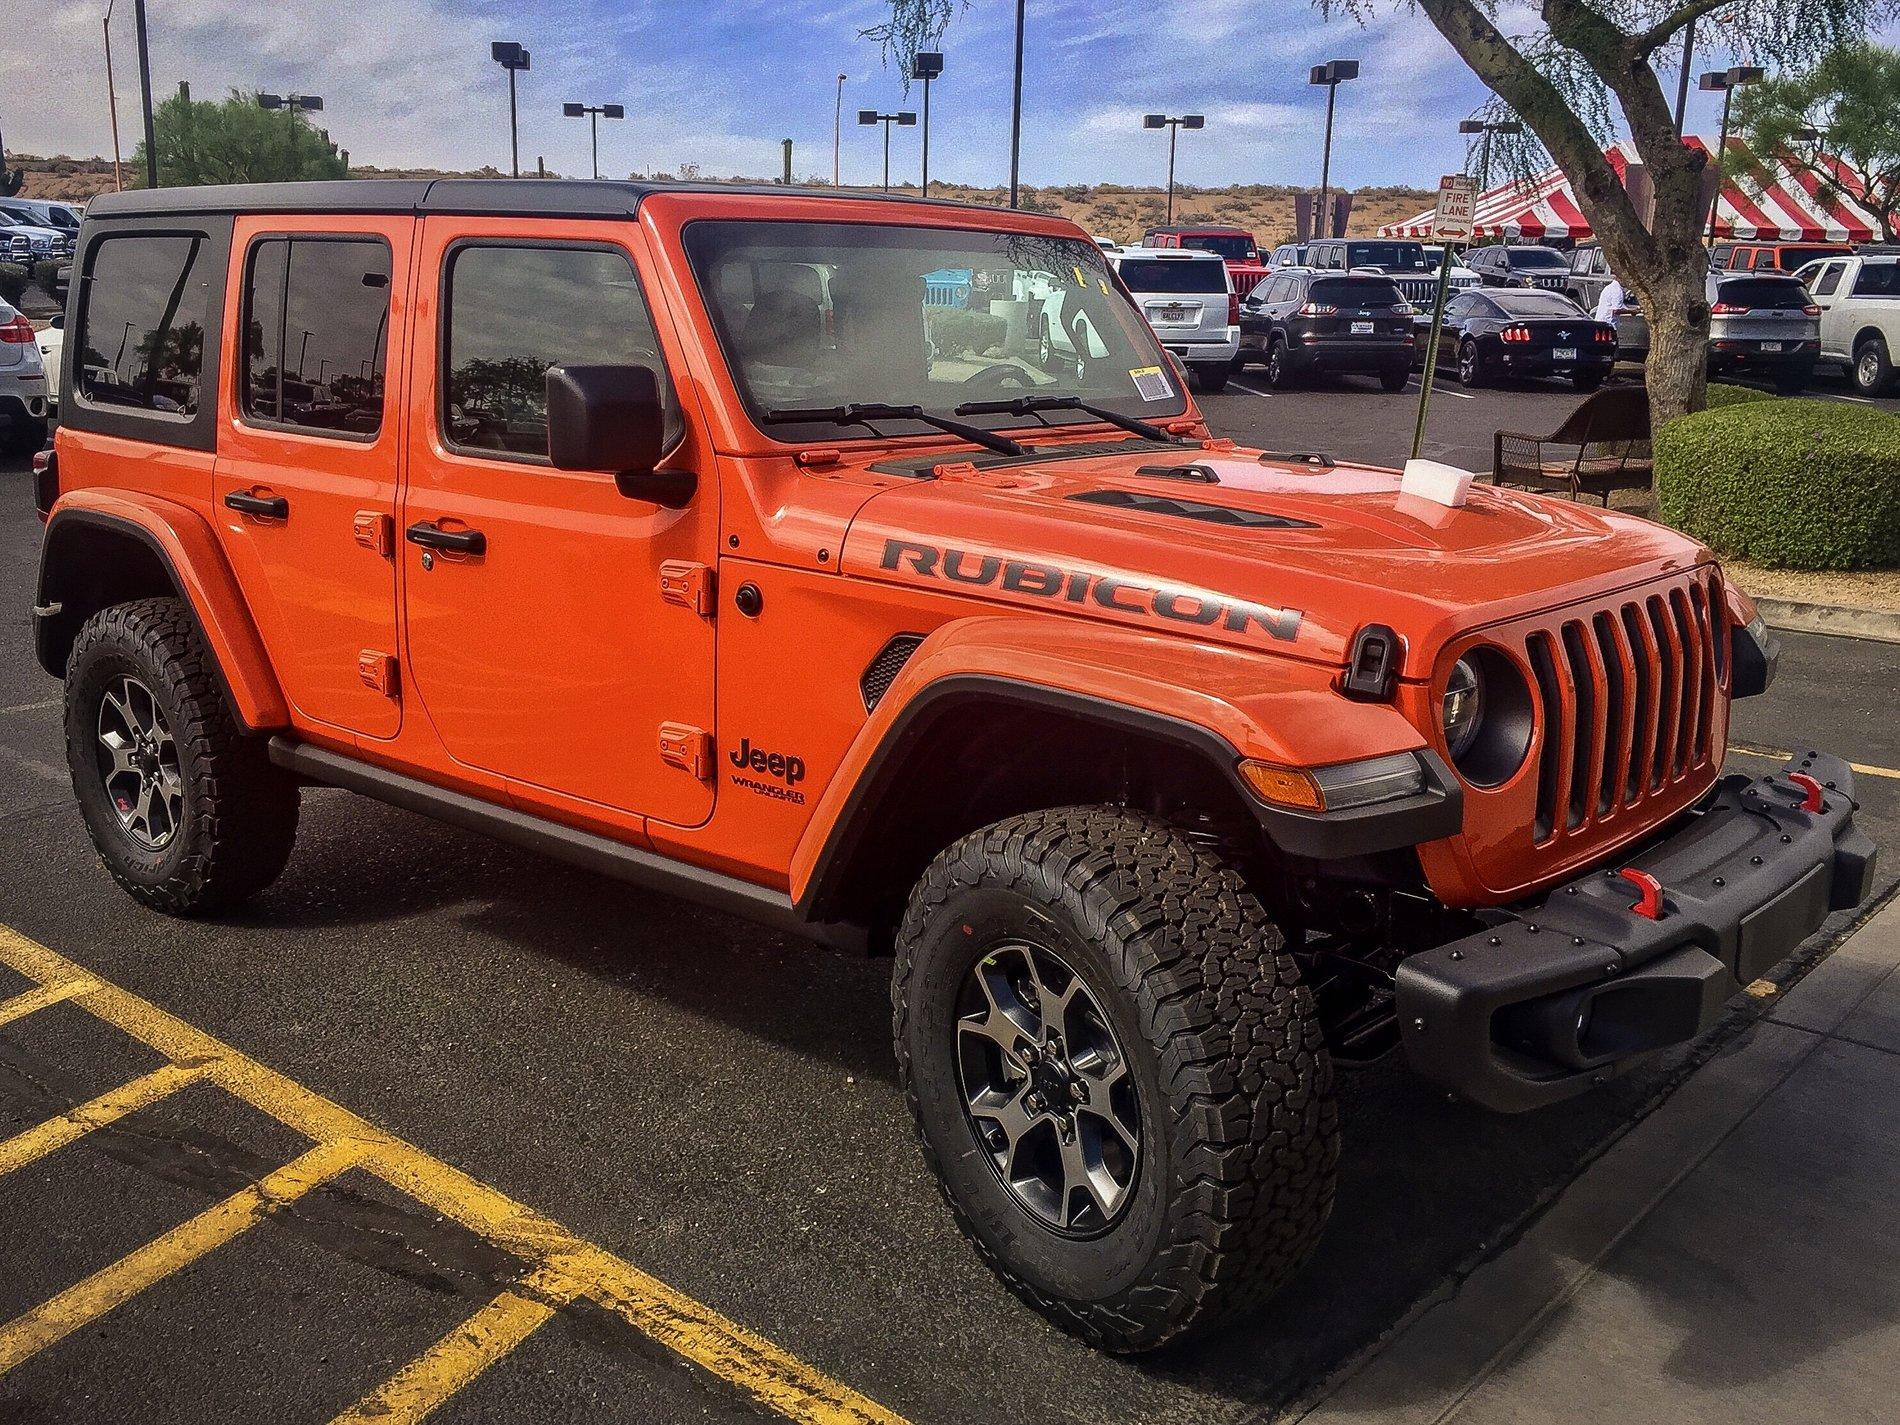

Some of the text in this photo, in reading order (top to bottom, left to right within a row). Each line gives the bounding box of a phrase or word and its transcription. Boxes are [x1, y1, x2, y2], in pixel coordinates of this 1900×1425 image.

[1442, 205, 1469, 216] LANE
[1446, 193, 1470, 203] FIRE
[879, 538, 1306, 642] RUBICON
[729, 737, 806, 786] Jeep
[731, 775, 805, 802] WRANGLER
